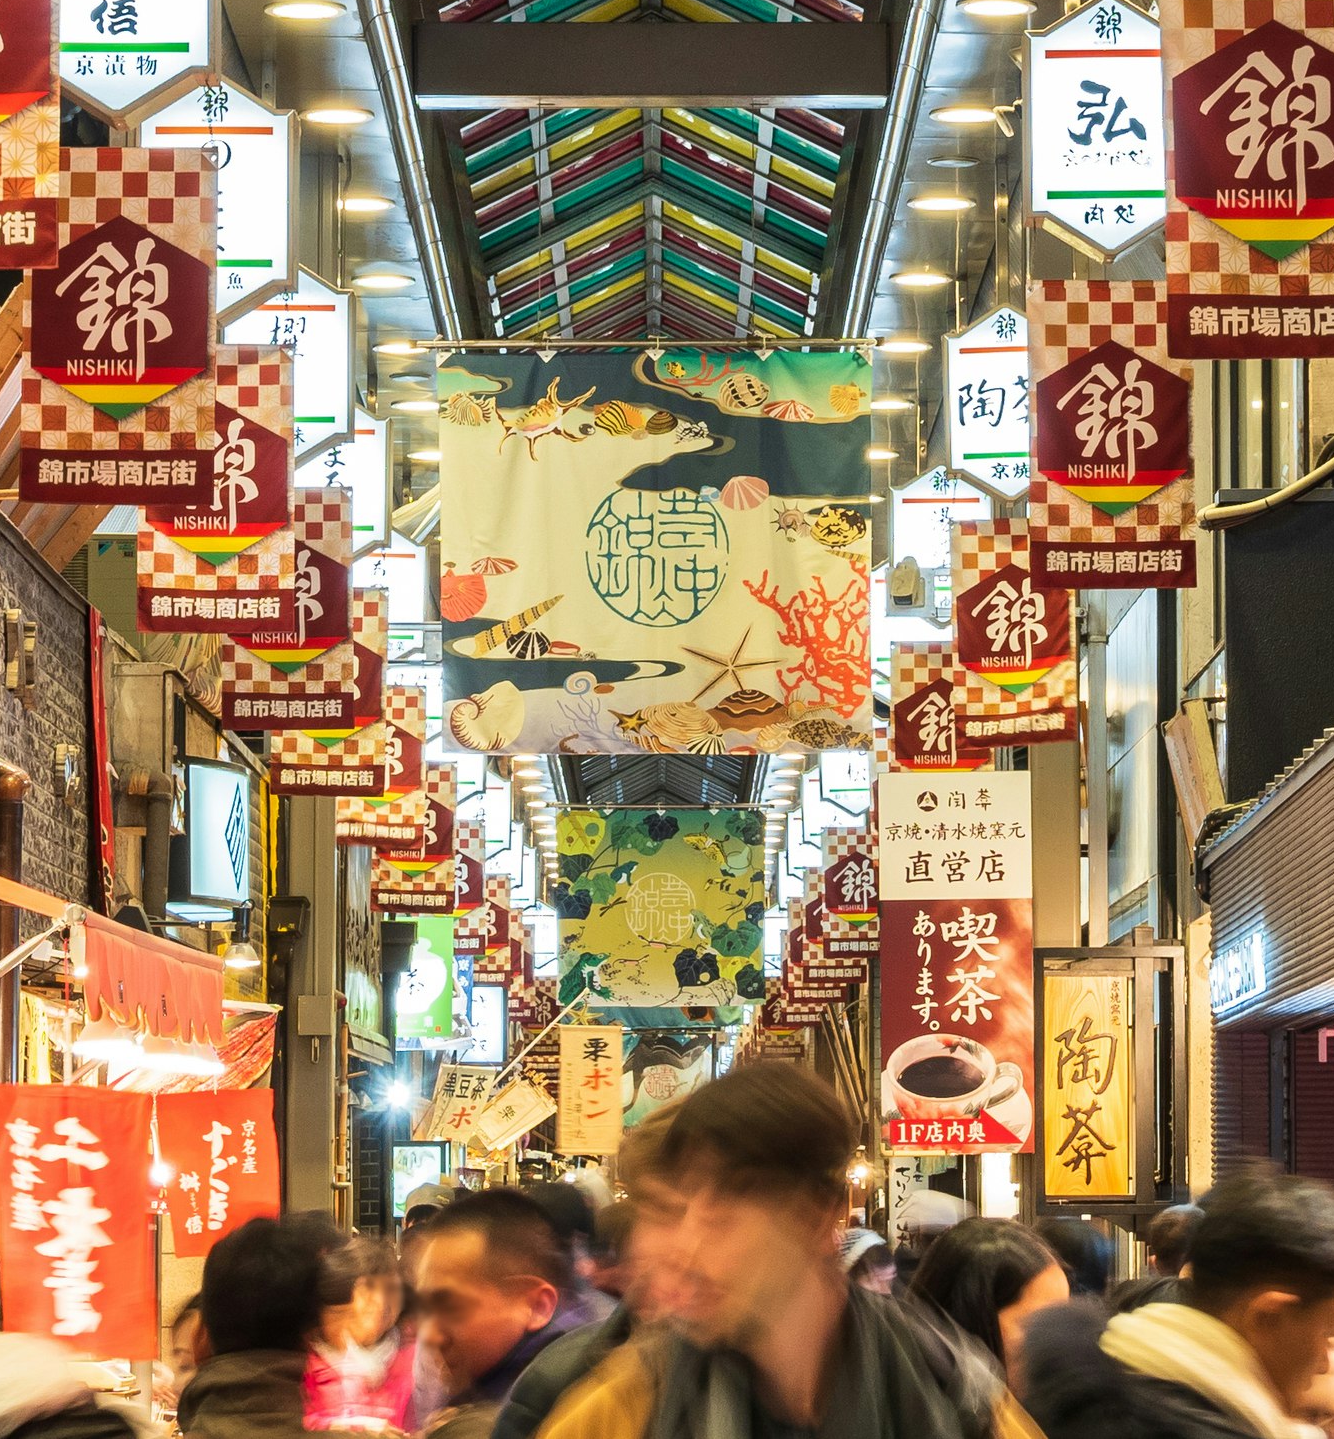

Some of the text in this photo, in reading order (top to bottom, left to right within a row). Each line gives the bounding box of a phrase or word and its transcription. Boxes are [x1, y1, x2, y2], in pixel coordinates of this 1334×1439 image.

[1089, 5, 1123, 45] 錦
[74, 54, 158, 76] 京漬物
[1067, 80, 1148, 145] 弘
[1216, 189, 1294, 211] NISHIKI
[1084, 203, 1135, 224] 肉処
[56, 238, 173, 383] 錦
[991, 313, 1017, 342] 錦
[67, 359, 134, 377] NISHIKI
[1056, 358, 1159, 484] 錦
[38, 458, 197, 488] 錦市場商店街
[1067, 463, 1126, 480] NISHIKI
[173, 515, 228, 531] NISHIKI
[1045, 549, 1184, 574] 錦市場商店街
[151, 595, 281, 621] 錦市場商店街
[971, 576, 1049, 670] 錦
[251, 632, 298, 645] NISHIKI
[981, 655, 1026, 668] NISHIKI
[233, 698, 343, 719] 錦市場商店街
[965, 712, 1067, 739] 錦市場商店街
[913, 754, 951, 765] NISHIKI
[280, 769, 375, 787] 錦市場商店街
[884, 821, 1026, 842] 京焼・清水焼窯元
[390, 850, 420, 859] NISHIKI
[905, 850, 1005, 884] 直営店
[833, 860, 878, 913] 錦
[377, 893, 448, 907] 錦市場商店街
[829, 941, 880, 952] 錦市場商店
[911, 909, 941, 1032] あります。
[941, 907, 1002, 1026] 喫茶
[443, 1071, 488, 1101] 黒豆茶
[896, 1120, 986, 1144] 1F店内奥
[241, 1119, 259, 1174] 京名産
[202, 1120, 238, 1231] すぐき
